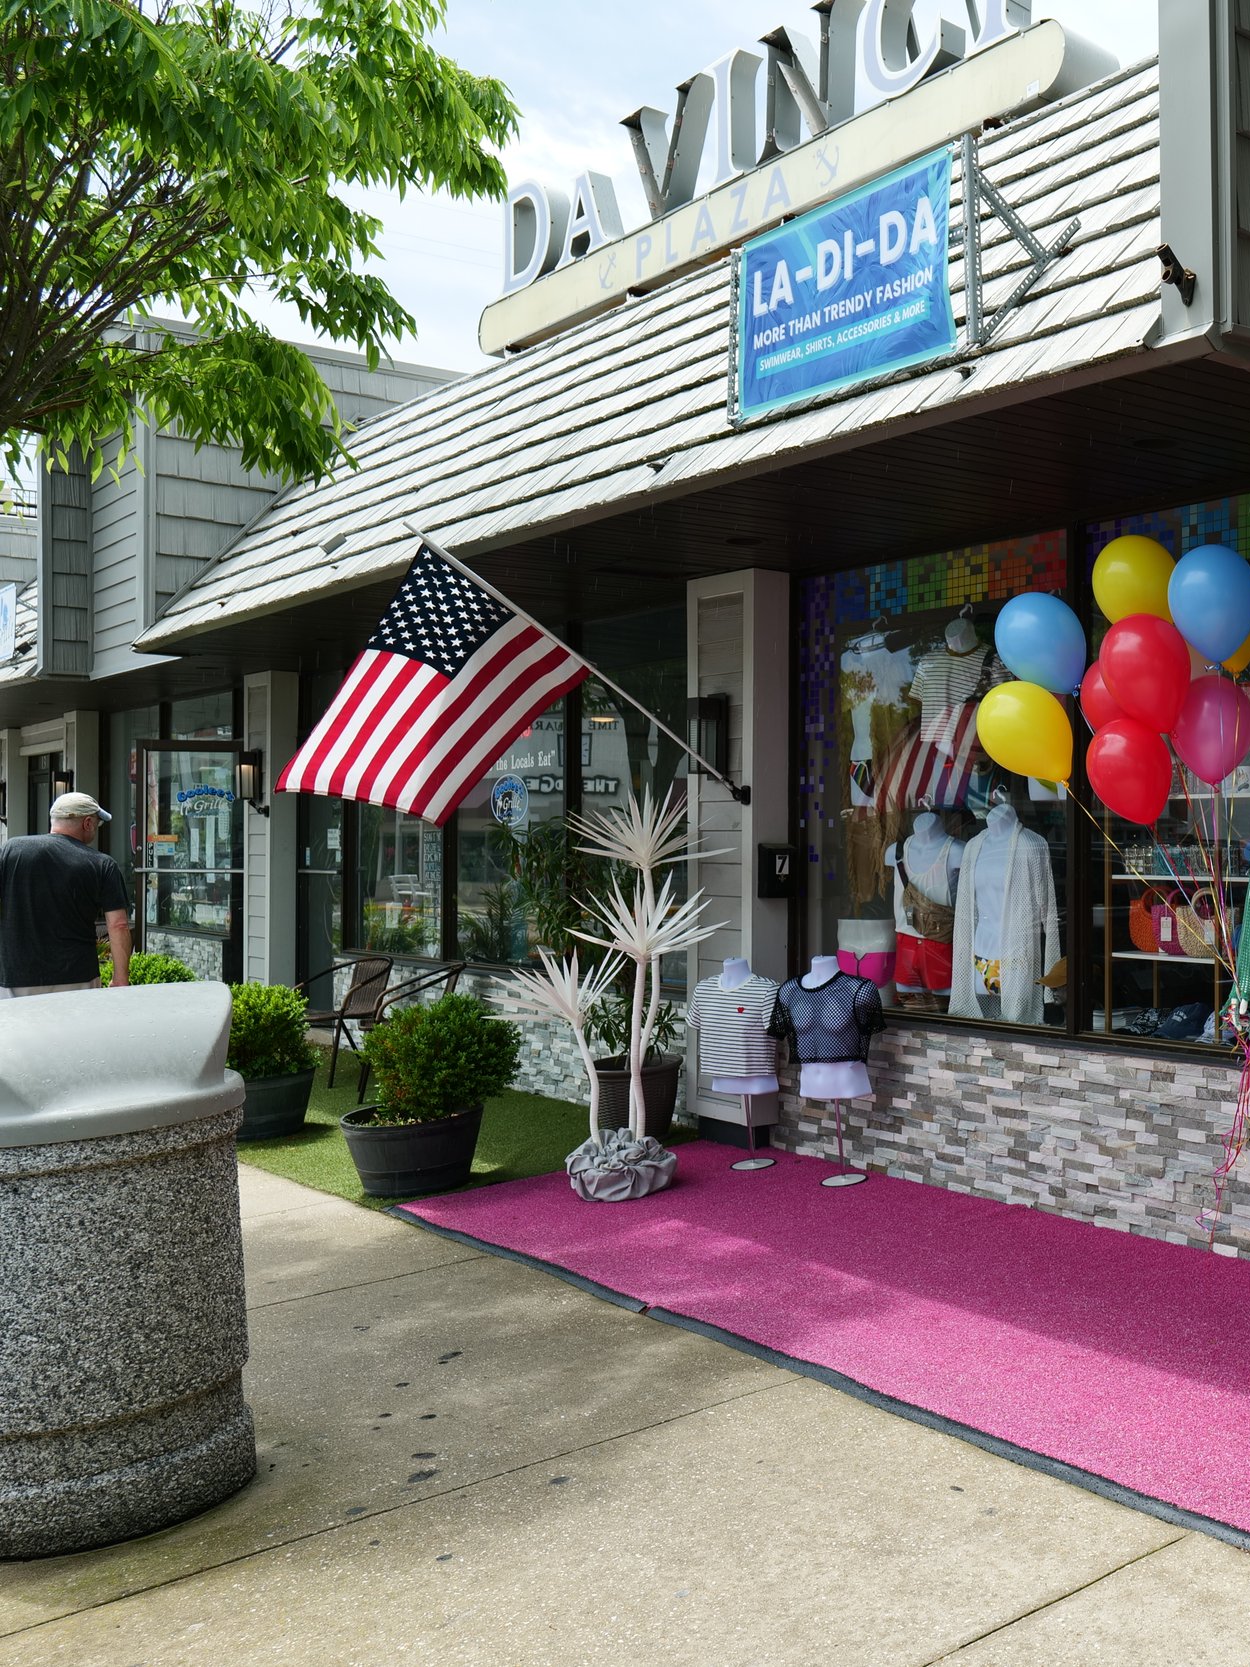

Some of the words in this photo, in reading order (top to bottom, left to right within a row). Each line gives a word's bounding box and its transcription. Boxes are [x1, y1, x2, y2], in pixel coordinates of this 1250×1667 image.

[635, 165, 792, 280] PLAZA
[752, 196, 938, 318] LA-DI-DA
[753, 325, 786, 350] MORE
[788, 310, 821, 335] THAN
[823, 290, 874, 323] TRENDY
[876, 264, 934, 305] FASHION
[759, 348, 804, 372] SWIMWEAR,
[805, 336, 835, 355] SHIRTS,
[836, 317, 892, 345] ACCESSORIES
[893, 310, 901, 323] &
[902, 300, 926, 320] MORE
[511, 752, 535, 770] Locals
[777, 855, 788, 874] 7
